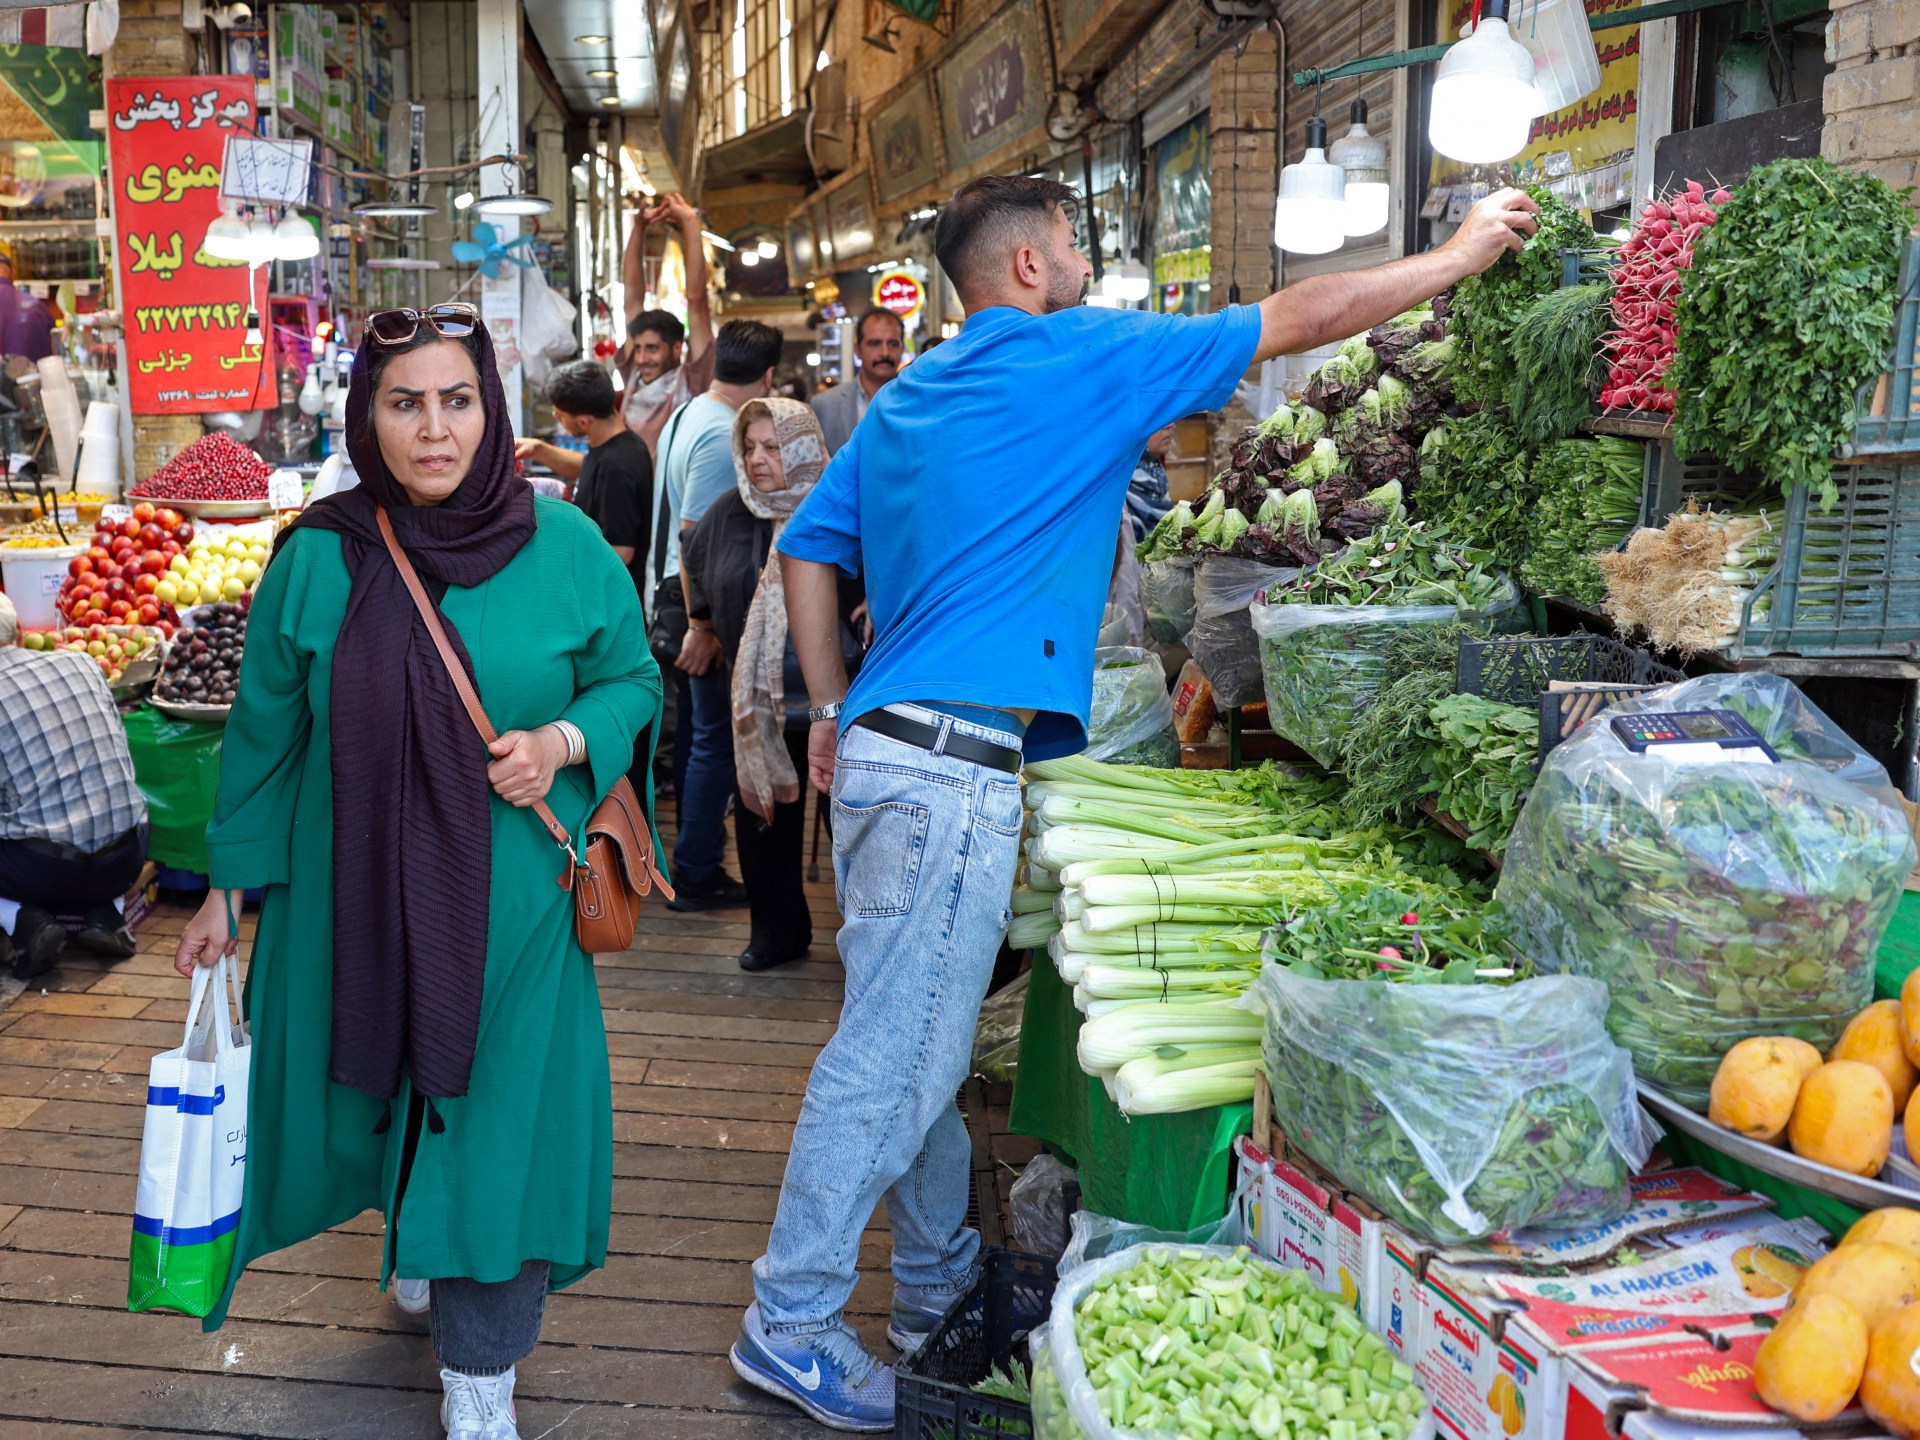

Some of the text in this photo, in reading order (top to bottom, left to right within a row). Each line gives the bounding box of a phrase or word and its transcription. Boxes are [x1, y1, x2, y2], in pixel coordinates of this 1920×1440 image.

[114, 88, 249, 131] مرکز پخش
[126, 154, 221, 203] منوی
[127, 231, 184, 280] لیلا
[1589, 1261, 1719, 1297] AL HAKEEM
